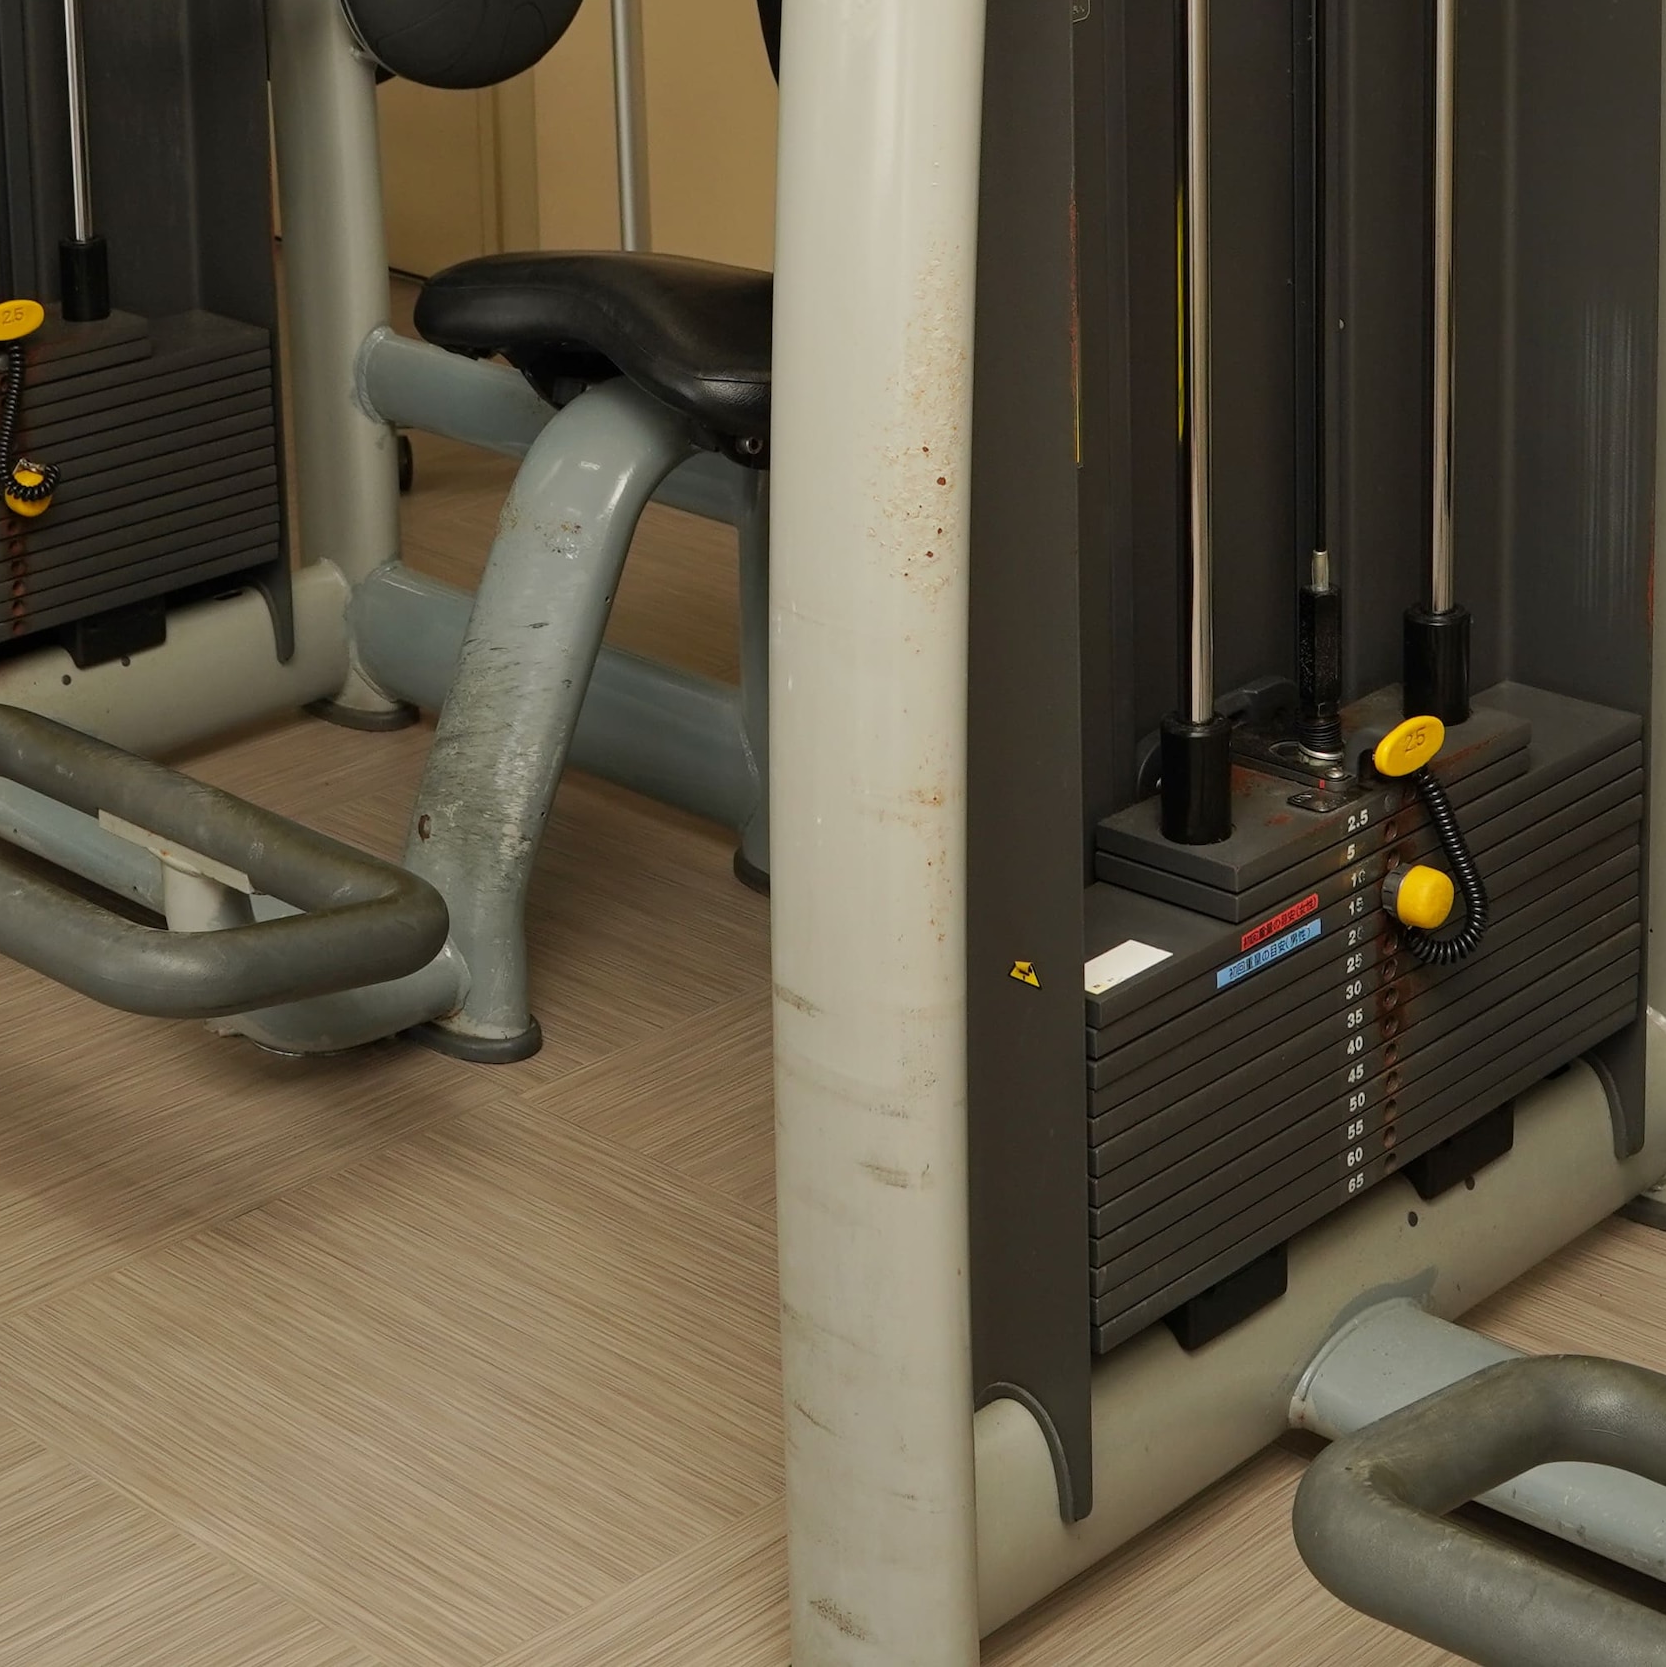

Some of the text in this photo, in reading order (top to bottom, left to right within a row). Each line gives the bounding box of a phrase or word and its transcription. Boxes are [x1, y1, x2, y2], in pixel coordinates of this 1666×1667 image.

[1347, 809, 1369, 832] 2.5
[1346, 843, 1356, 860] 5
[1348, 897, 1364, 916] 15
[1346, 953, 1363, 974] 25
[1345, 981, 1363, 1000] 30
[1347, 1008, 1364, 1028] 35
[1346, 1035, 1364, 1056] 40
[1347, 1063, 1365, 1084] 45
[1349, 1092, 1366, 1112] 50
[1347, 1119, 1365, 1139] 55
[1347, 1146, 1364, 1167] 60
[1347, 1172, 1365, 1193] 65
